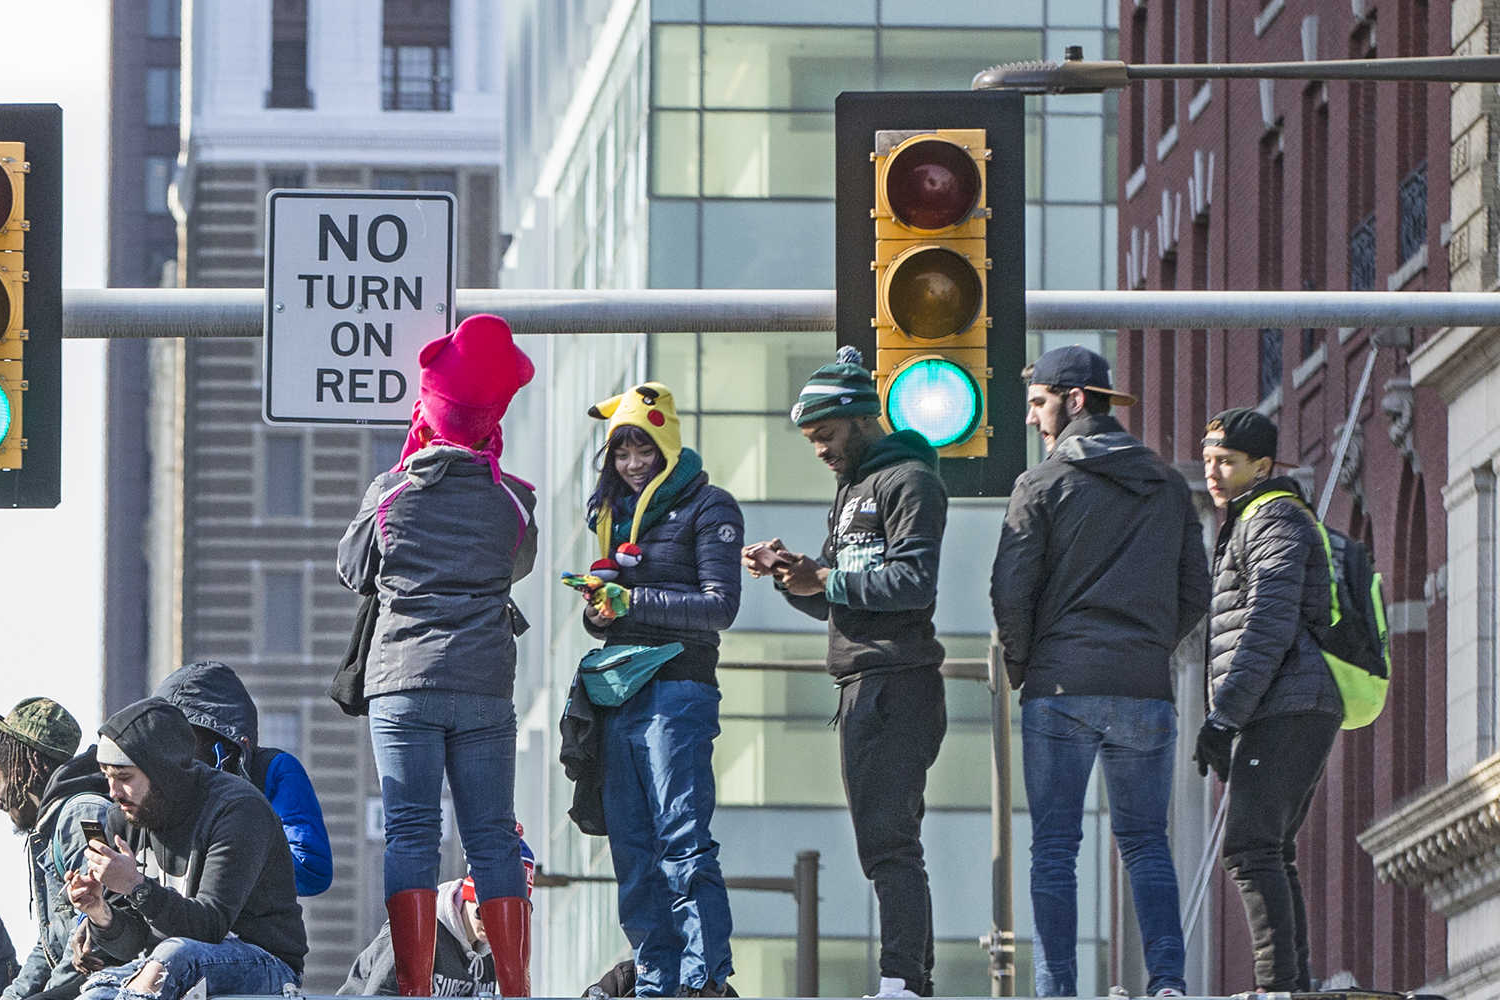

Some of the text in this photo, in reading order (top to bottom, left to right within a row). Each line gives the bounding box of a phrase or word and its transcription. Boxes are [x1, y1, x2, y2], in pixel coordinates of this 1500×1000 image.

[318, 213, 408, 263] NO
[297, 274, 423, 311] TURN
[330, 321, 393, 357] ON
[315, 367, 408, 404] RED
